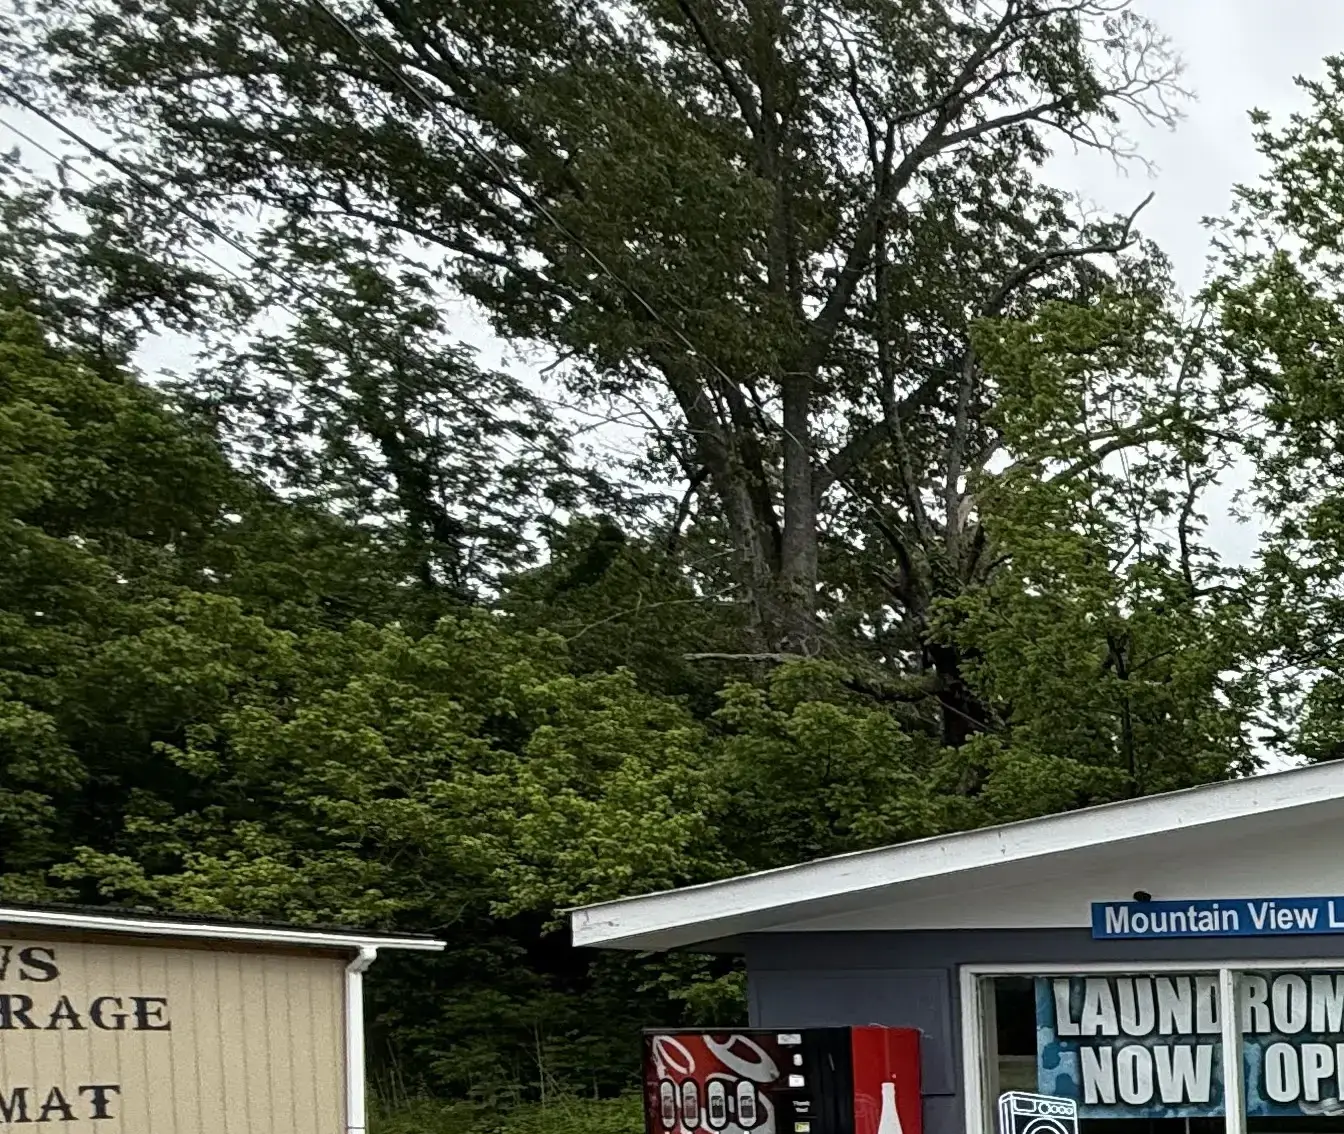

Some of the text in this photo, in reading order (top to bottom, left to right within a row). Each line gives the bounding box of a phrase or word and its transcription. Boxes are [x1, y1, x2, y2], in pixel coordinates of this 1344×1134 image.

[1104, 902, 1240, 935] Mountain
[1247, 901, 1319, 931] View
[1080, 1044, 1213, 1105] NOW
